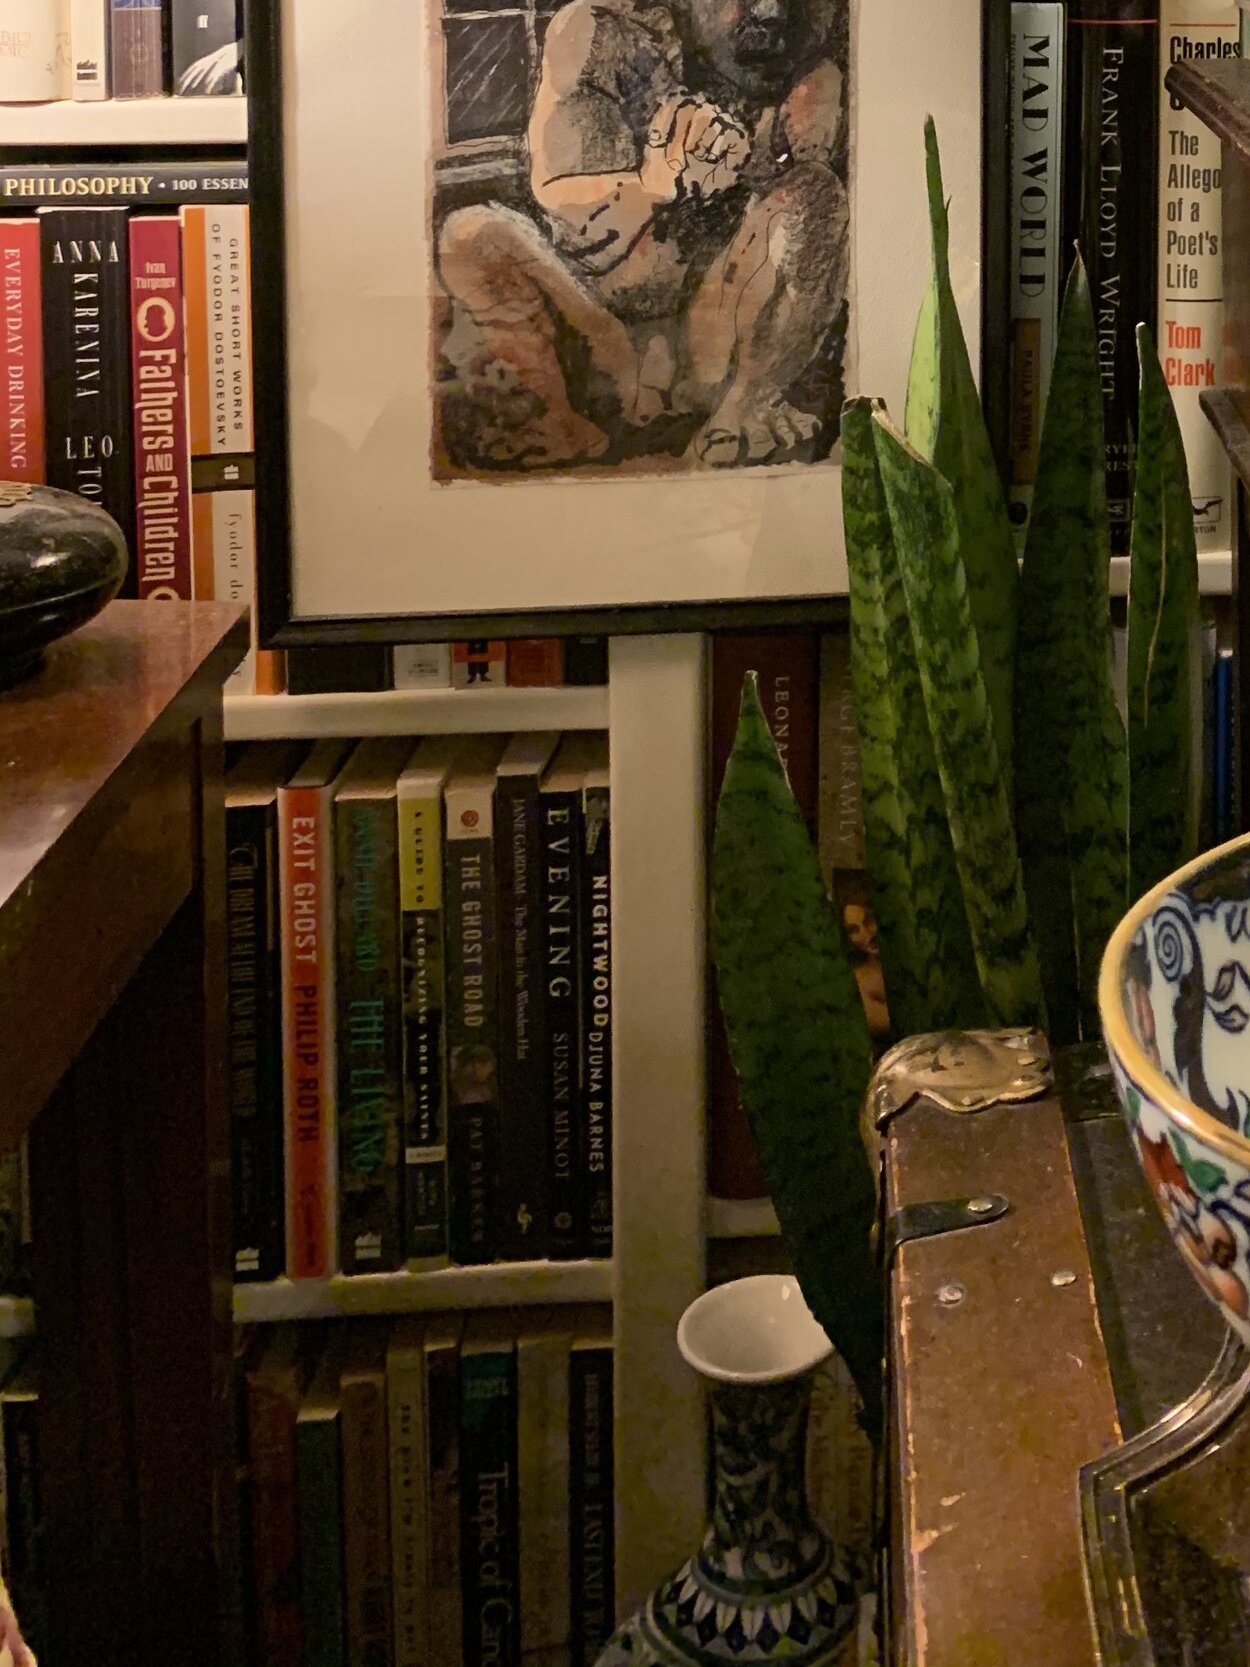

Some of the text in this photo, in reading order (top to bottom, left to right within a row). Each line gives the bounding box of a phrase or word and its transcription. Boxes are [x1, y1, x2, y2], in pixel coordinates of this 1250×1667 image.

[4, 176, 154, 196] PHILOSOPHY
[171, 178, 198, 191] 100
[1019, 34, 1050, 299] MAD WORLD
[1168, 129, 1200, 157] The
[52, 240, 120, 264] ANNA
[1098, 46, 1125, 401] FRANK LLOYD WRIGHT
[1166, 197, 1201, 223] of a
[1166, 229, 1219, 257] Poet's
[144, 261, 167, 275] Ivan
[1165, 262, 1200, 289] Life
[4, 248, 28, 470] EVERYDAY DRINKING
[73, 272, 101, 398] KARENINA
[210, 223, 227, 447] OF FYODOR DOSTOEVSKY
[228, 237, 244, 431] GREAT SHORT WORKS
[1164, 320, 1202, 350] Tom
[1164, 357, 1216, 387] Clark
[65, 434, 114, 460] LEO
[135, 348, 180, 583] Fathers AND Children
[292, 816, 321, 1143] EXIT GHOST PHILIP ROTH
[460, 852, 487, 1028] THE GHOST ROAD
[349, 998, 385, 1054] THE
[547, 808, 572, 1181] EVENING SUSAN MINOT
[588, 874, 609, 1173] NIGHTWOOD DJUNA BARNES
[472, 1461, 511, 1557] Tropic
